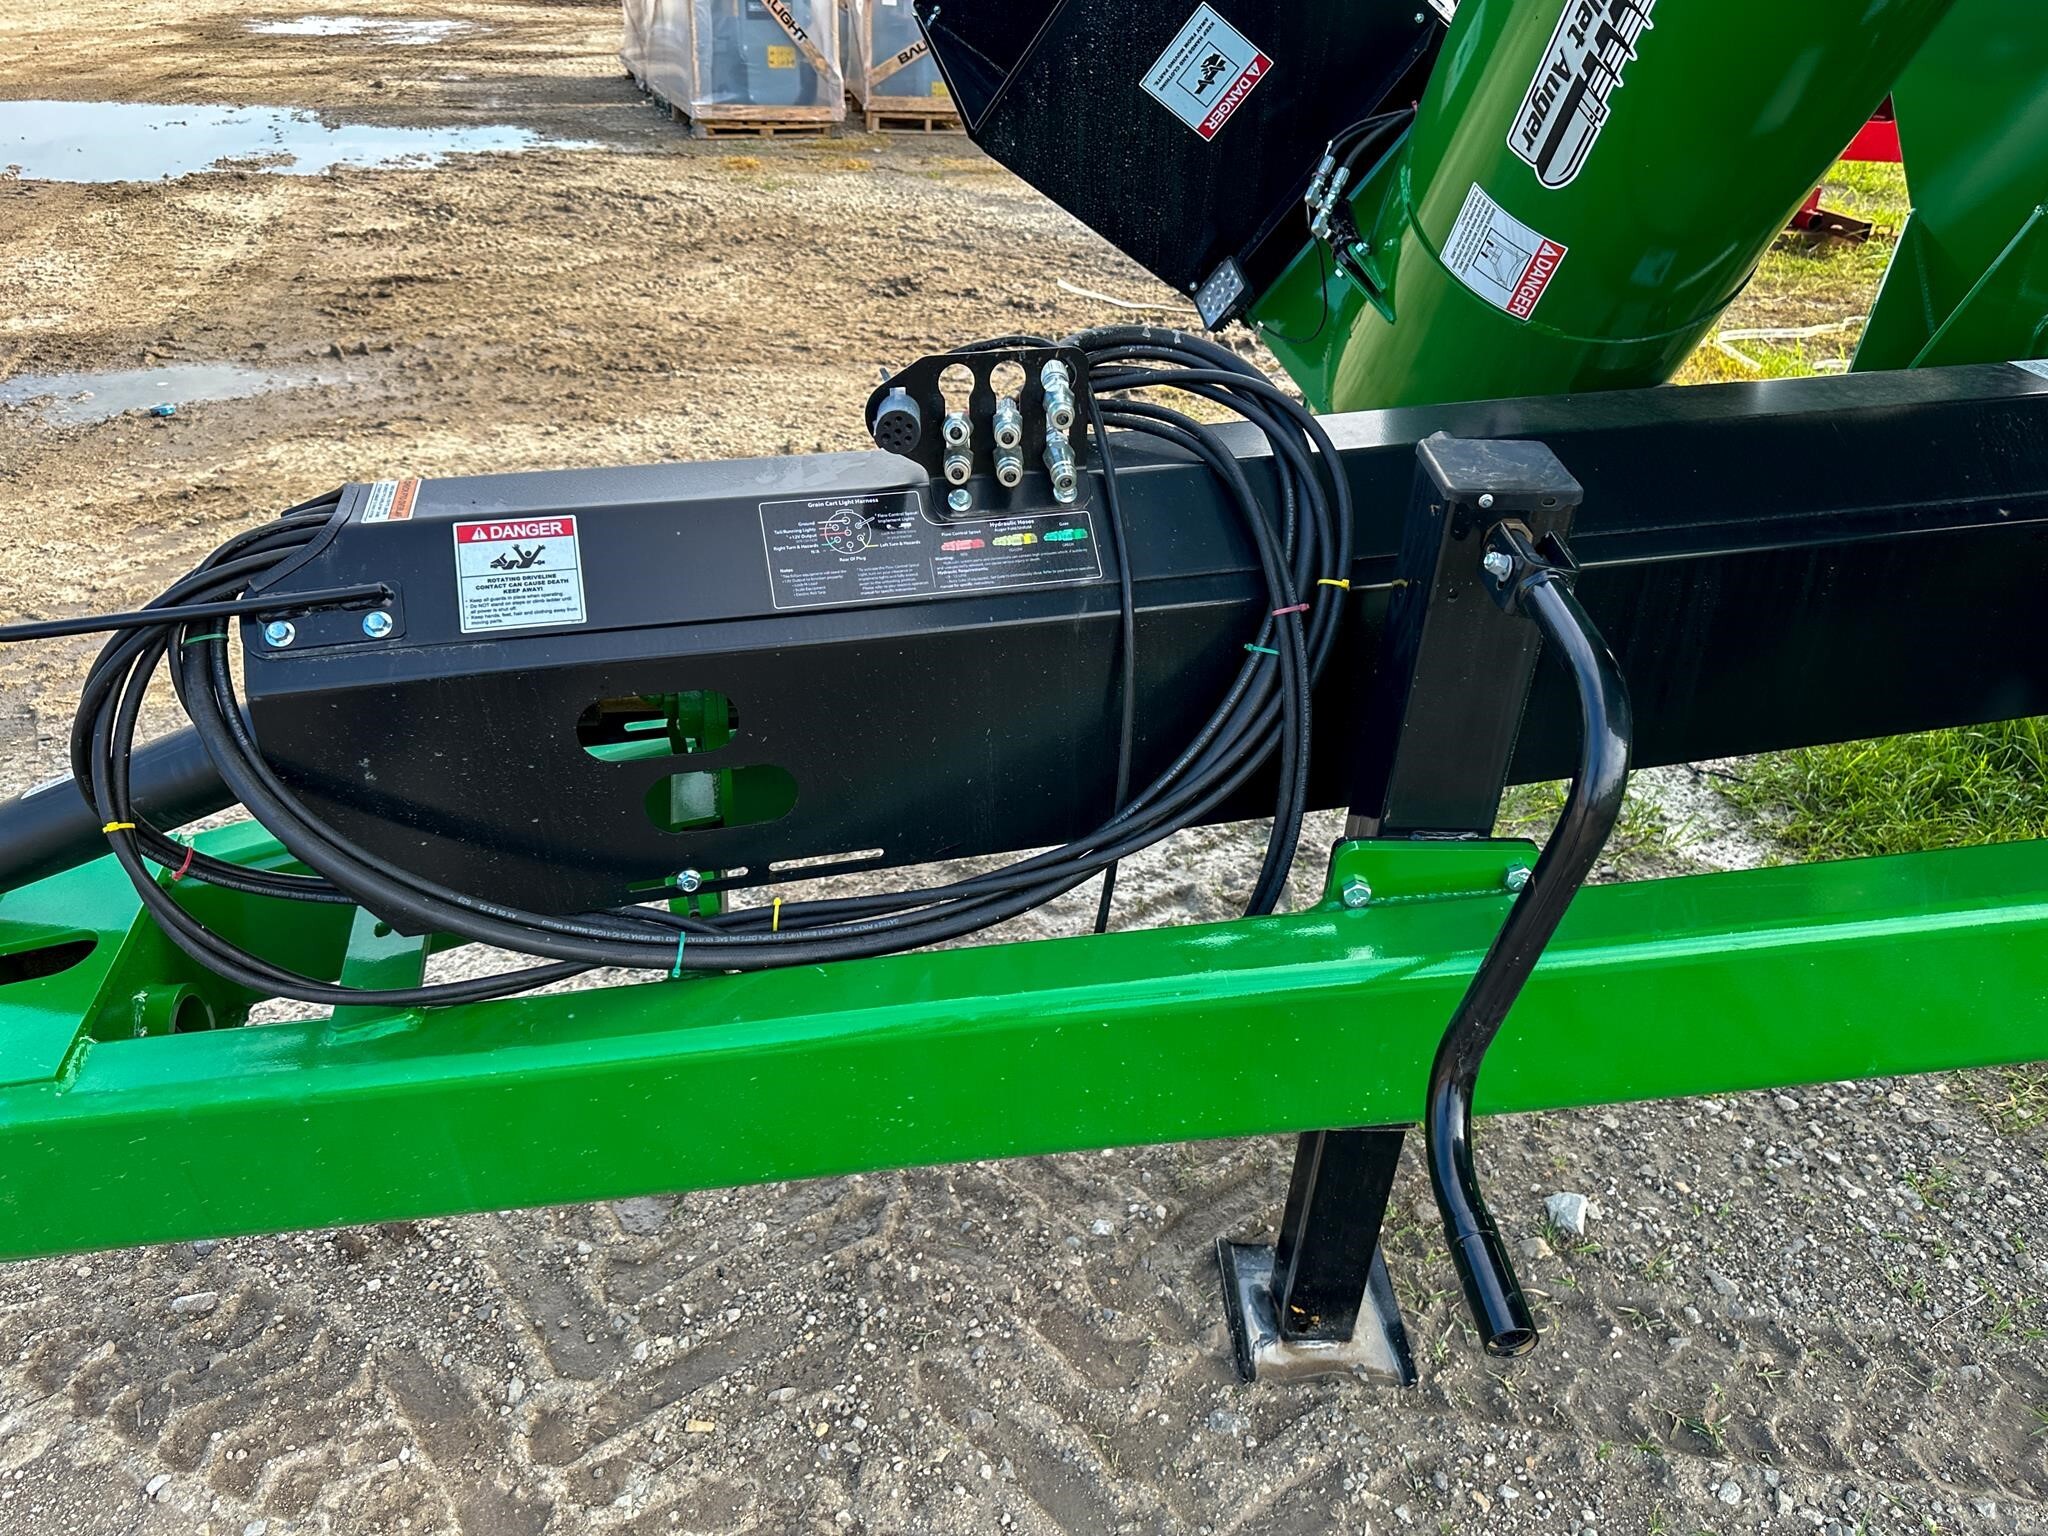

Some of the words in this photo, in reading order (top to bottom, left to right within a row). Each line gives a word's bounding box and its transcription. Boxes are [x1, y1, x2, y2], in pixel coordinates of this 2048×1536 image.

[765, 0, 808, 41] LIGHT
[1195, 17, 1210, 33] AWAY
[1202, 21, 1215, 37] KEEP
[1183, 32, 1197, 48] FROM
[1188, 35, 1204, 55] HANDS
[1167, 47, 1185, 69] MOVING
[1178, 54, 1189, 67] AND
[1158, 65, 1180, 92] CLOTHING
[1204, 77, 1252, 130] DANGER
[1522, 47, 1572, 152] Auger
[1510, 252, 1554, 315] DANGER
[490, 522, 563, 539] DANGER
[990, 520, 1017, 528] Hydraulic
